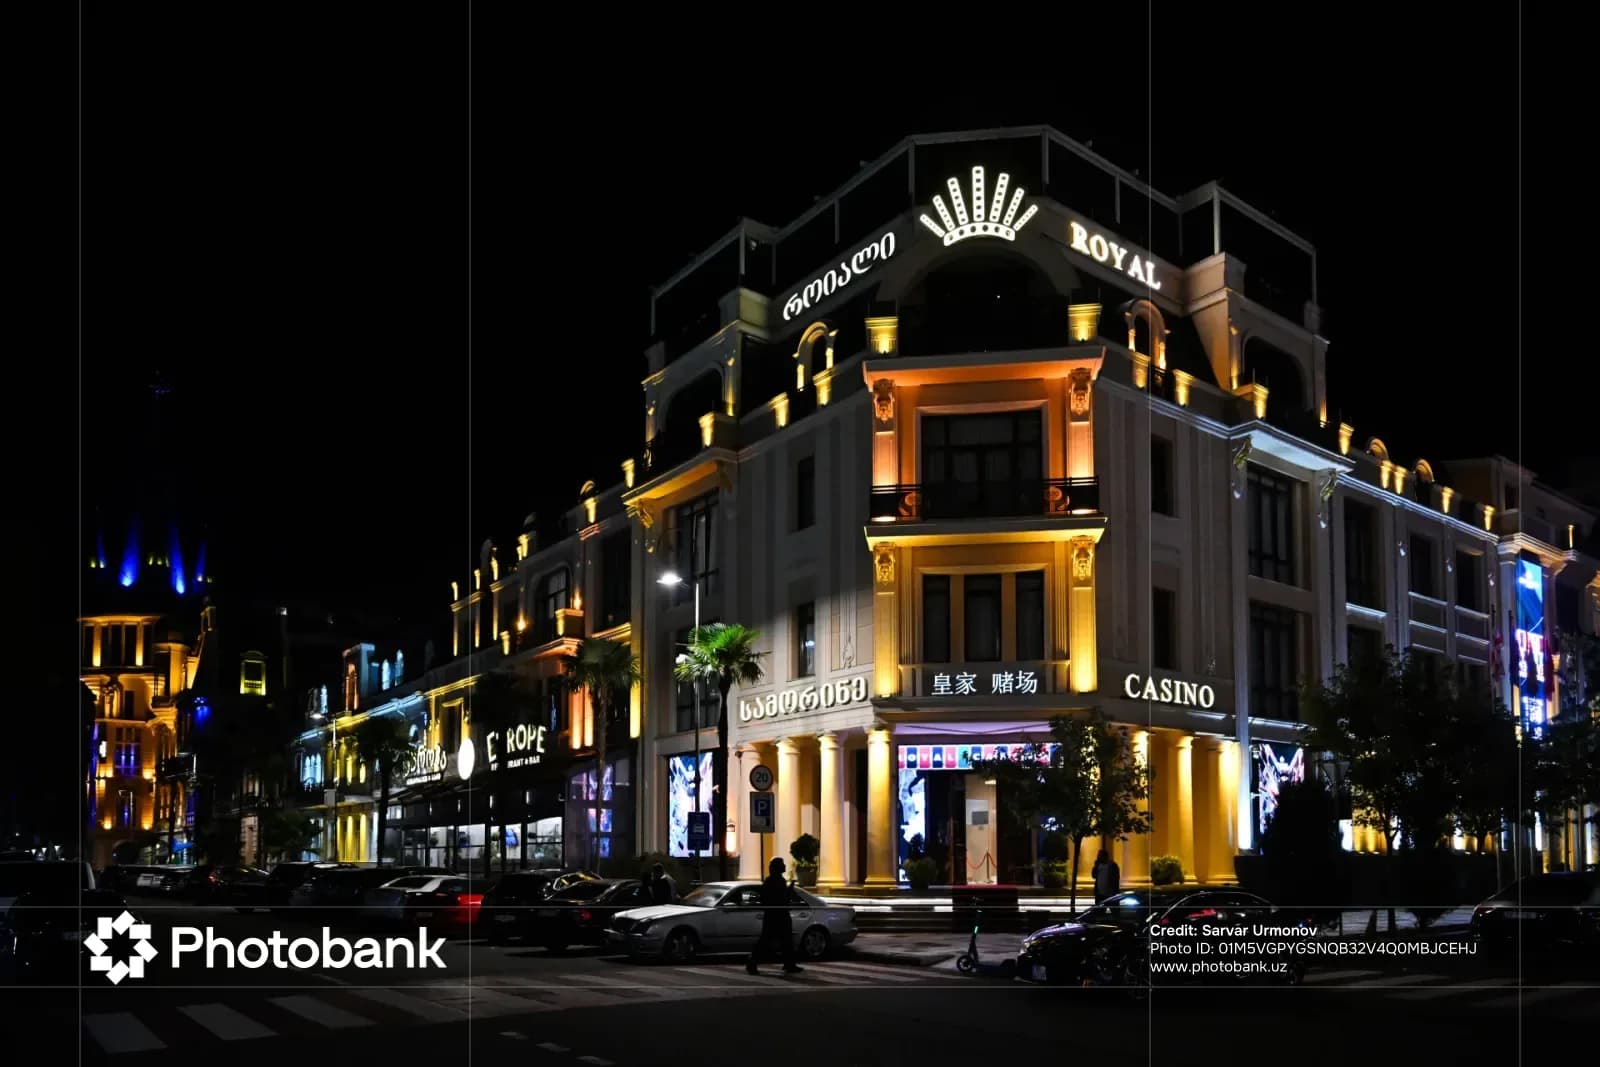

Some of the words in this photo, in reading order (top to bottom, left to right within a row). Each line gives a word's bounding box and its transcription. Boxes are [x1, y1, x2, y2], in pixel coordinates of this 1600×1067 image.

[1070, 221, 1162, 291] ROYAL
[782, 231, 896, 321] როიალი
[932, 672, 977, 695] 皇家
[991, 670, 1038, 694] 赌场
[1124, 673, 1215, 708] CASINO
[486, 723, 547, 763] EROPE
[756, 771, 769, 783] 20
[758, 800, 768, 816] P
